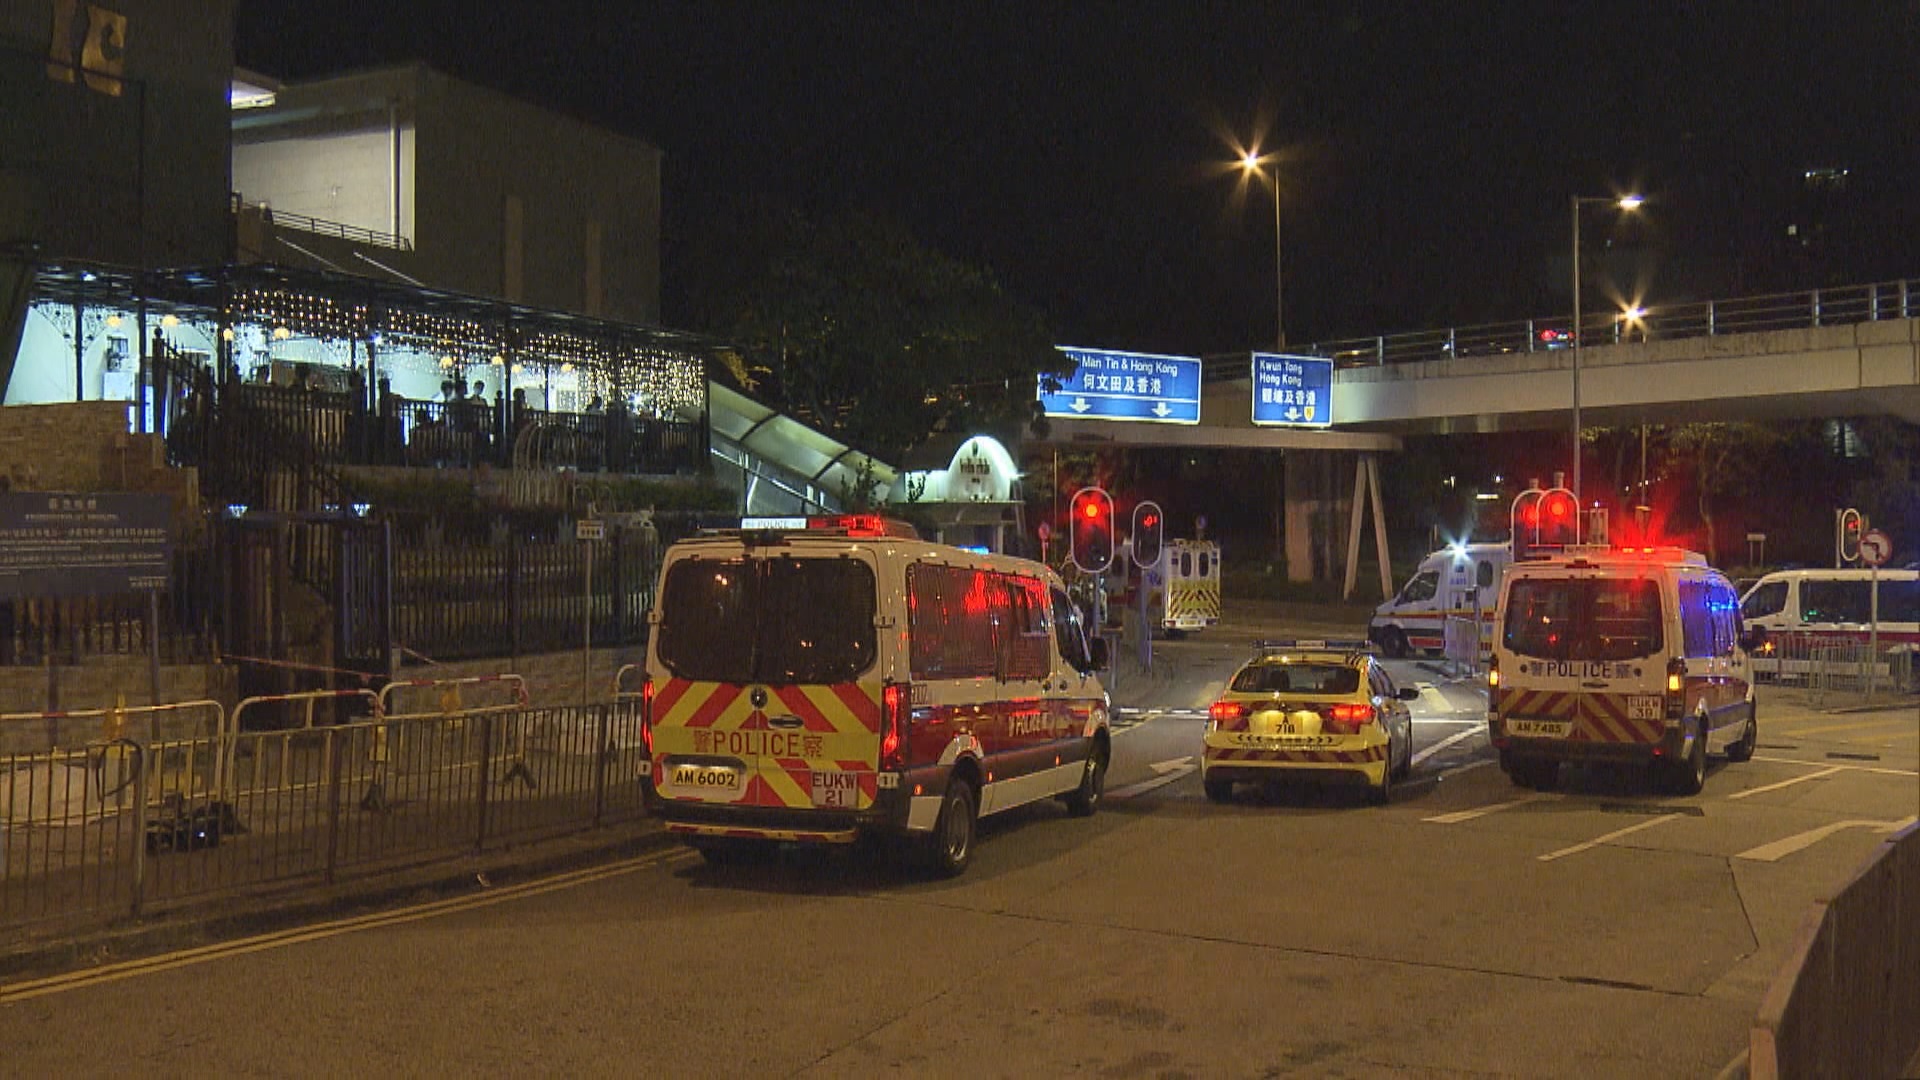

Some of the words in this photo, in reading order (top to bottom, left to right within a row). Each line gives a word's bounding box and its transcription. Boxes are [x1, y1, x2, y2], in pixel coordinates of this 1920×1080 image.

[1081, 355, 1102, 369] Man
[1106, 357, 1119, 369] Tin
[1121, 359, 1128, 370] &
[1130, 361, 1154, 374] Hong
[1156, 362, 1178, 377] Kong
[1259, 360, 1282, 371] Kwun
[1284, 361, 1303, 375] Tong
[1083, 373, 1162, 395] 何文田及香港
[1259, 372, 1281, 386] Hong
[1282, 374, 1302, 387] Kong
[1547, 662, 1610, 678] POLICE
[713, 731, 800, 757] POLICE
[803, 734, 823, 758] 察
[676, 770, 694, 783] AM
[698, 772, 735, 787] 6002
[812, 772, 856, 789] EUKW
[825, 790, 842, 805] 21
